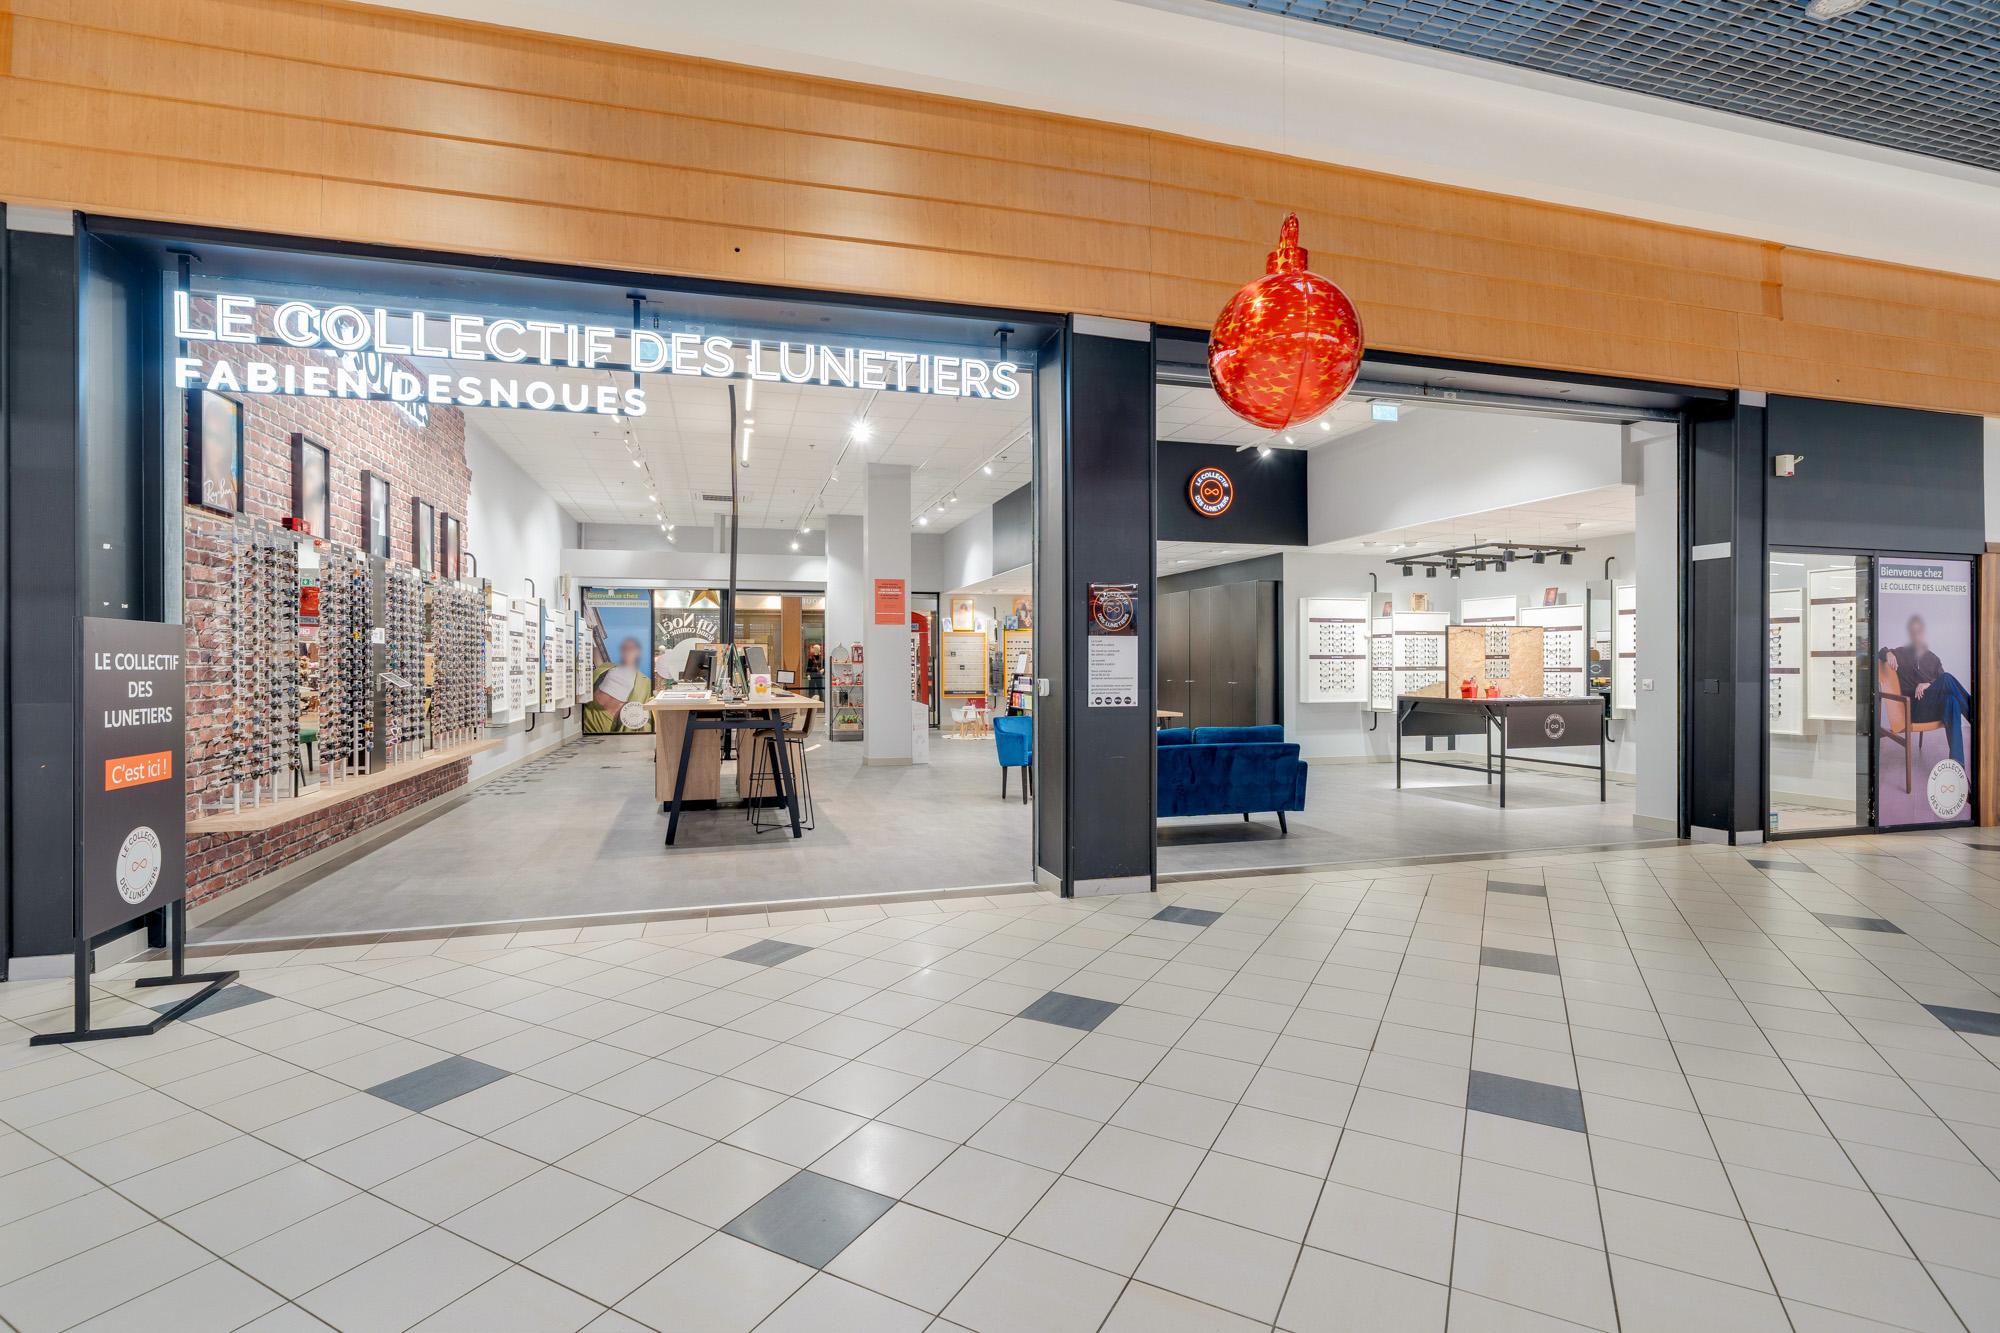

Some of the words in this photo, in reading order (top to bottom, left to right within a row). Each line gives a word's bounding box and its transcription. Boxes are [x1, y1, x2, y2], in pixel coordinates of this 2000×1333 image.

[173, 290, 256, 343] LE
[273, 301, 615, 368] COLLECTIF
[630, 329, 735, 378] DES
[750, 338, 1020, 400] LUNETIERS
[174, 357, 368, 400] FABIEN
[391, 371, 647, 417] DESNOUES
[1196, 478, 1203, 486] LE
[1201, 472, 1229, 487] COLLECTIF
[1195, 495, 1204, 507] DES
[1203, 496, 1229, 511] LUNETIERS
[1881, 567, 1923, 577] Bienvenue
[1924, 568, 1942, 578] chez
[1889, 583, 1921, 591] COLLECTIF
[1922, 584, 1934, 592] DES
[1935, 584, 1966, 592] LUNETIERS
[95, 652, 111, 671] LE
[115, 653, 179, 671] COLLECTIF
[128, 681, 153, 698] DES
[104, 706, 173, 728] LUNETIERS
[112, 761, 145, 784] C'est
[147, 759, 161, 778] ici
[1931, 771, 1938, 781] LE
[1937, 763, 1965, 780] COLLECTIF
[1930, 794, 1939, 809] DES
[1938, 793, 1965, 815] LUNETIERS
[121, 843, 130, 858] LE
[128, 830, 159, 850] COLLECTIF
[119, 876, 129, 894] DES
[128, 865, 159, 900] LUNETIERS
